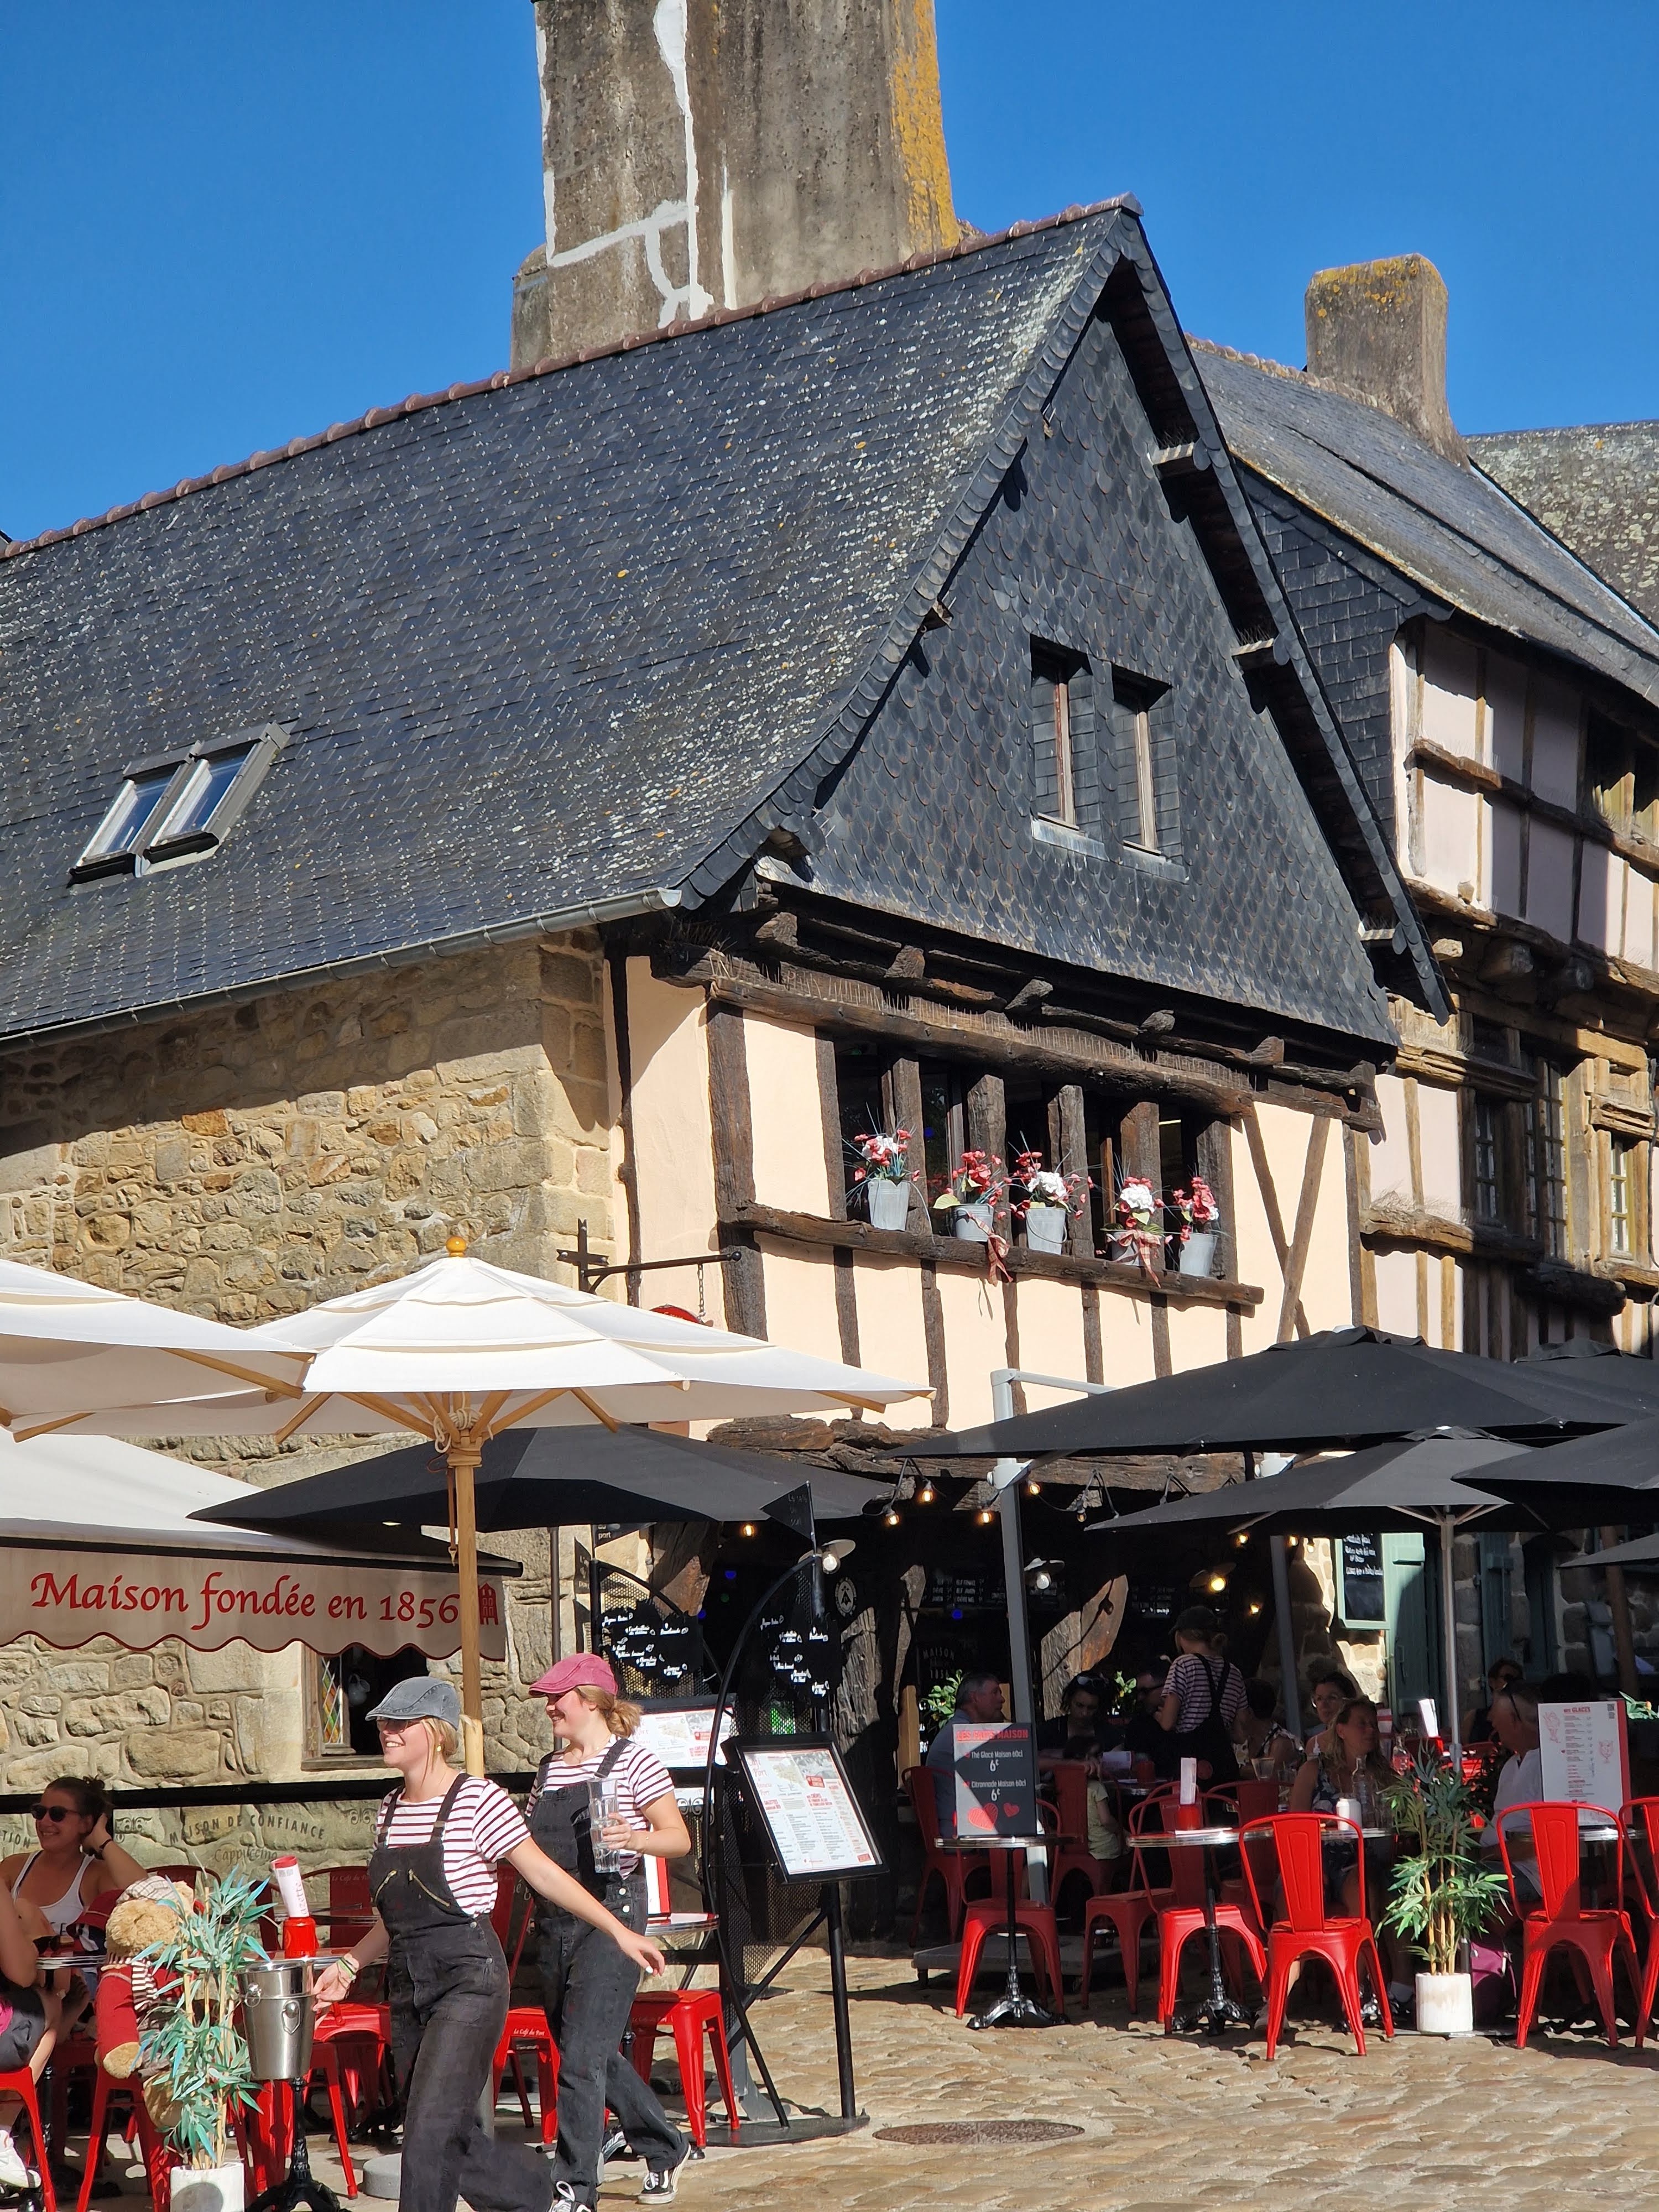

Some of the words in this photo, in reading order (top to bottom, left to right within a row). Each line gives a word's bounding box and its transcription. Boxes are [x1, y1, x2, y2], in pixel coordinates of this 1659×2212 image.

[30, 1572, 189, 1613] Maison
[190, 1572, 316, 1630] fondée
[328, 1594, 367, 1620] en
[380, 1591, 460, 1629] 1856
[956, 1730, 971, 1740] LES
[997, 1729, 1028, 1739] MAISON
[228, 1815, 242, 1827] DE
[250, 1814, 325, 1839] CONFIANCE
[295, 1881, 307, 1915] azette
